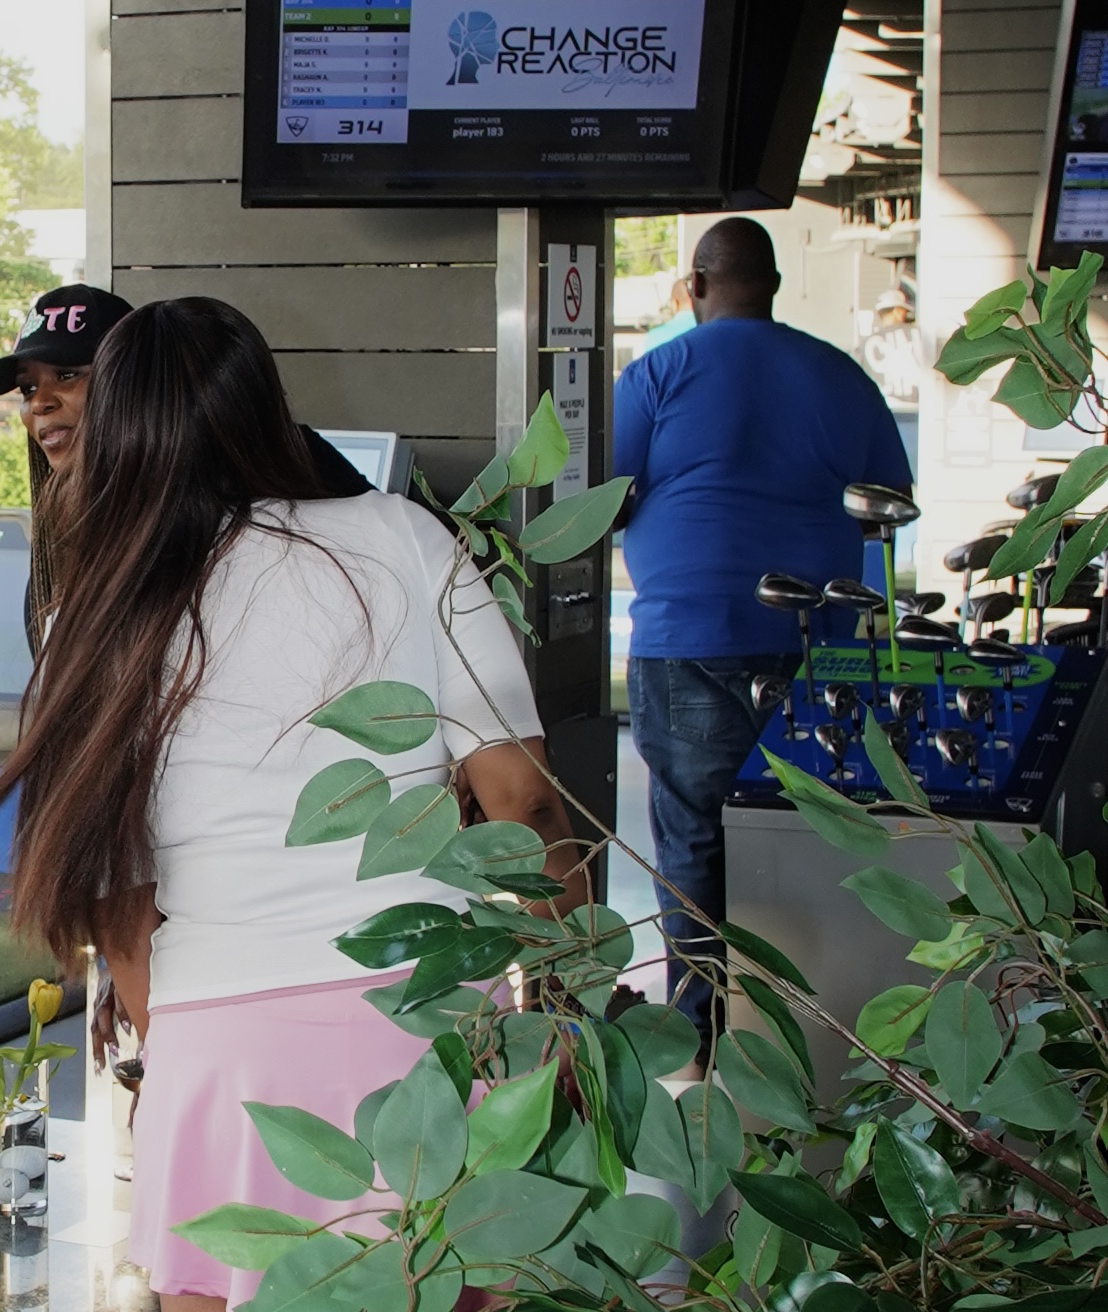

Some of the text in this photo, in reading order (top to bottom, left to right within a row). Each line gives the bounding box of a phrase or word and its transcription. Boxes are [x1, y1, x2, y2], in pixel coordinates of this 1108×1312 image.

[501, 26, 667, 51] CHANGE
[496, 51, 676, 75] REACTION
[337, 120, 384, 135] 314
[452, 126, 504, 138] player 183
[571, 126, 601, 137] 0 PTS
[640, 126, 670, 137] 0 PTS
[341, 153, 354, 162] PM
[547, 153, 577, 162] HOURS
